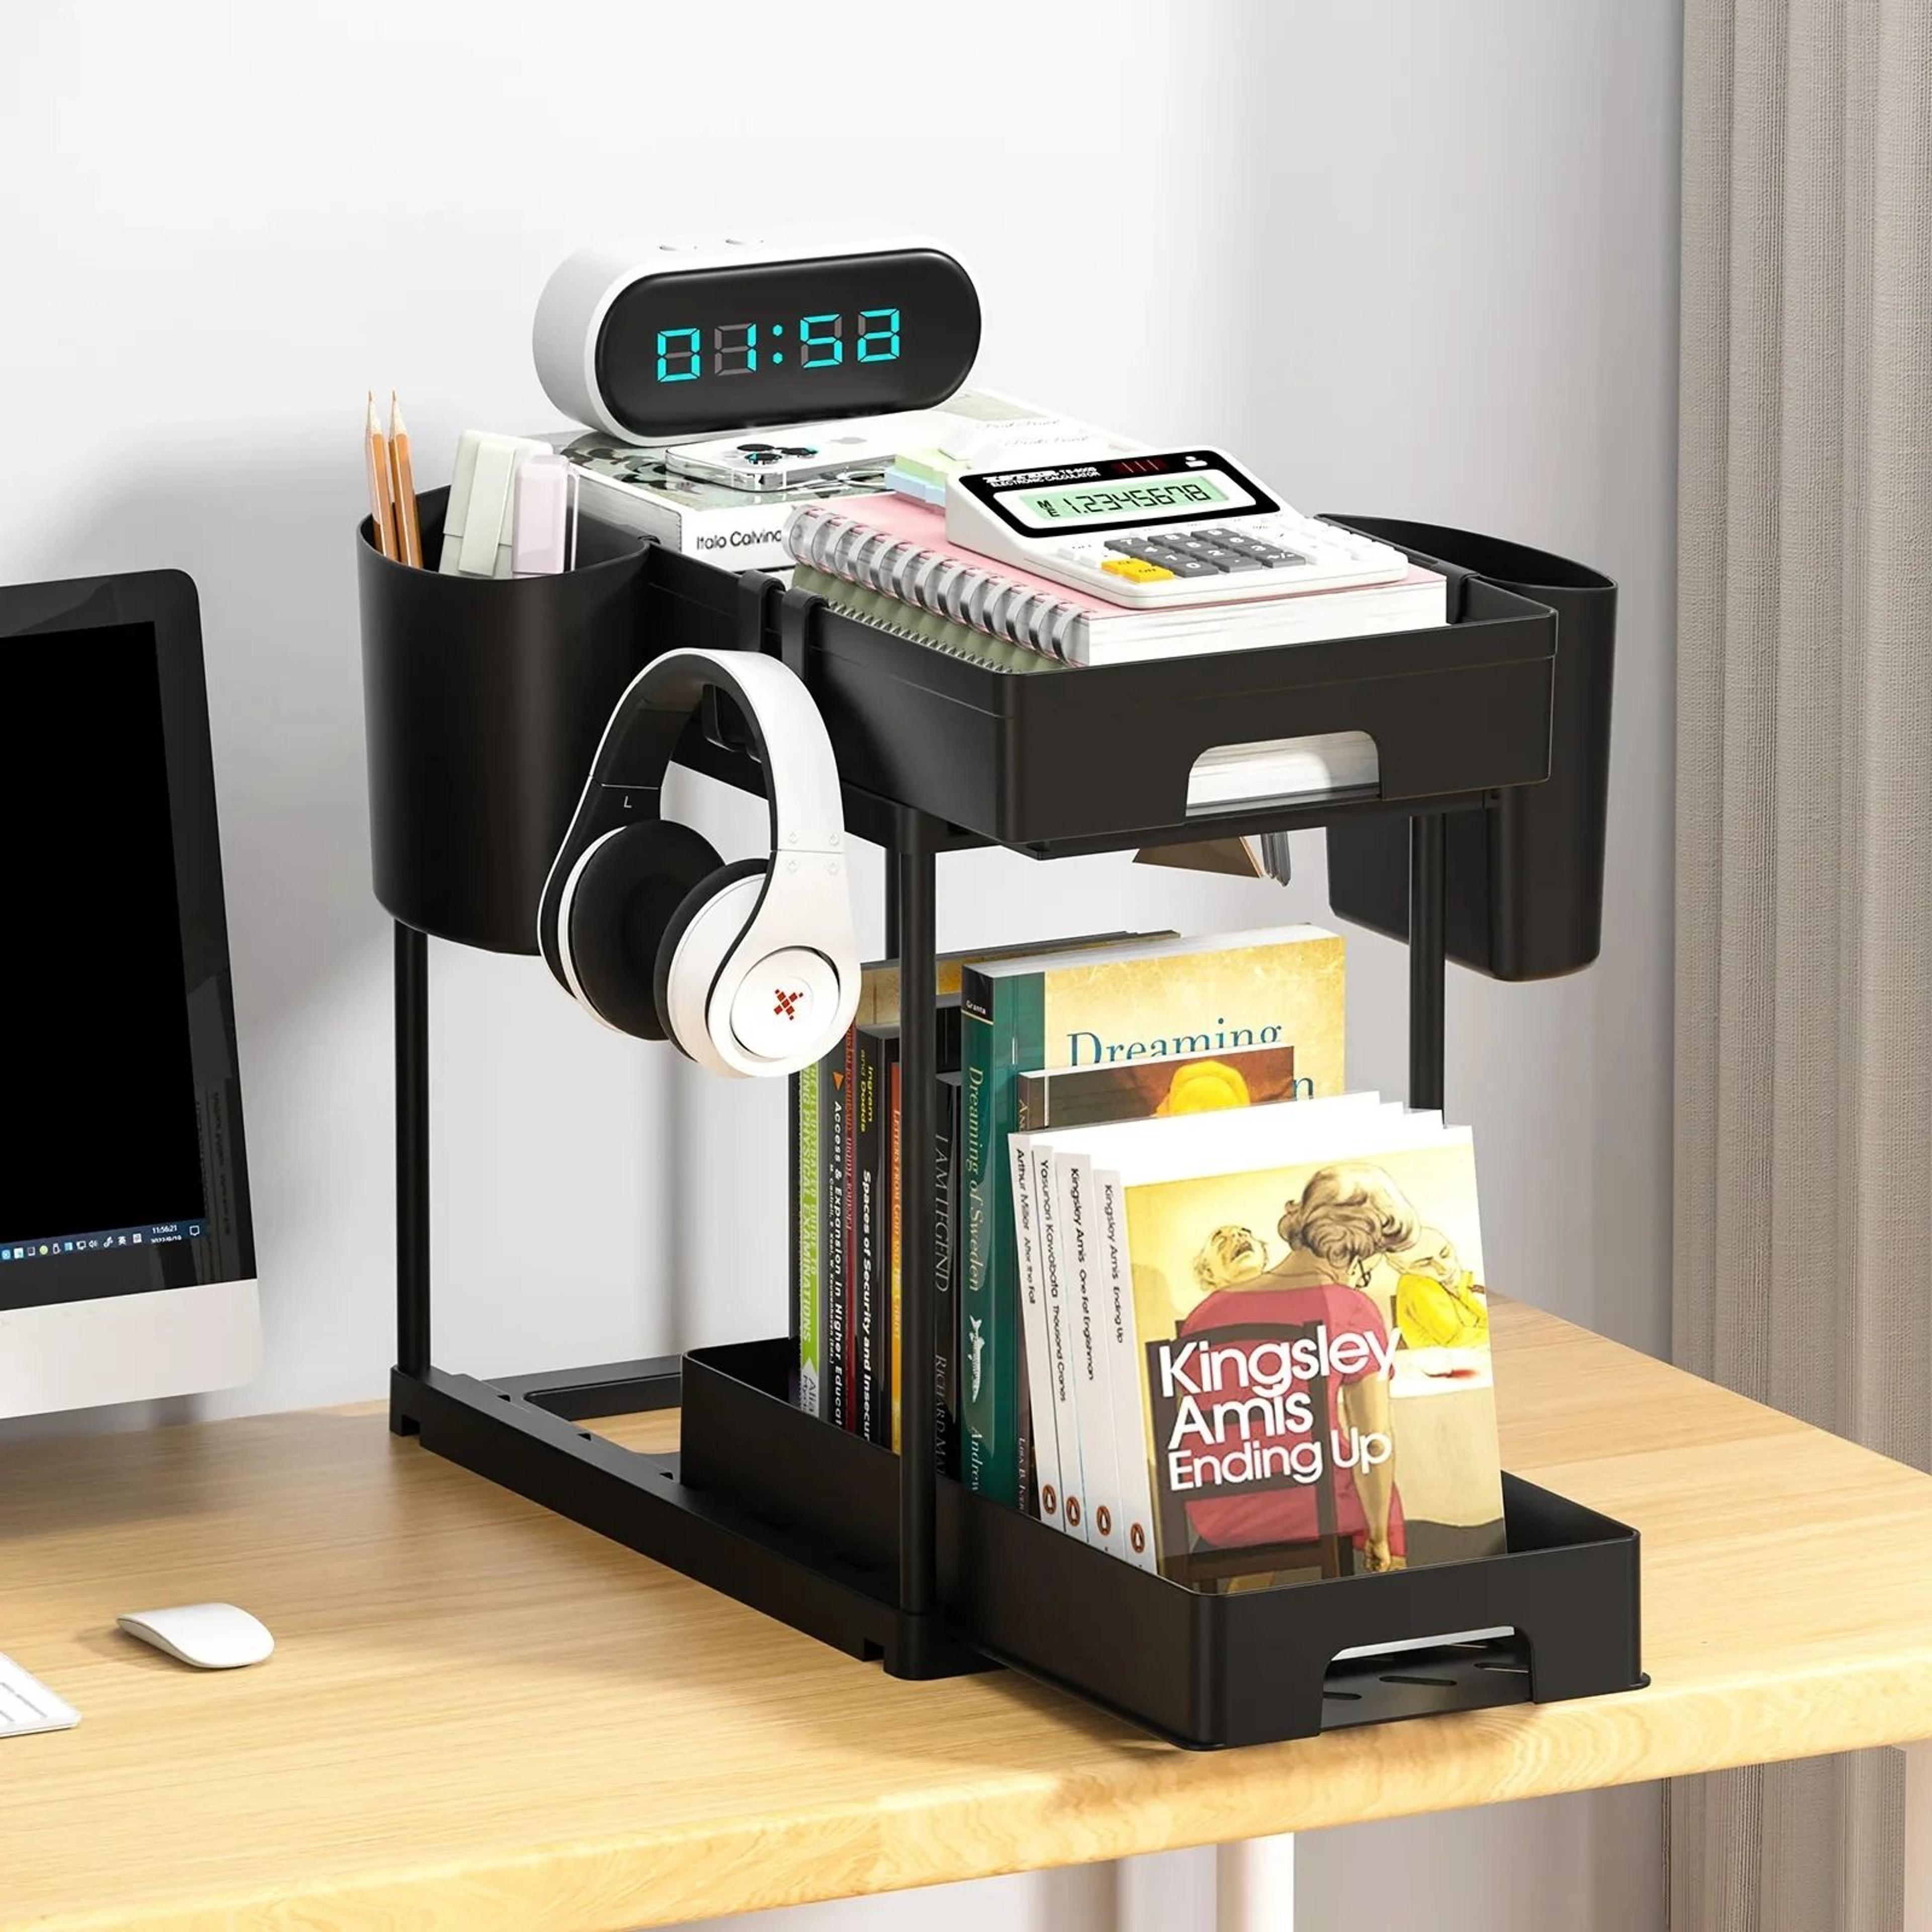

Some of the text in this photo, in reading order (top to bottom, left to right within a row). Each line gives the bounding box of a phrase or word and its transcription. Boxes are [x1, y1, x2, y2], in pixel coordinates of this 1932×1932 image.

[1063, 484, 1211, 514] 1.2345678
[696, 534, 727, 550] Italo
[623, 795, 632, 809] L
[965, 999, 987, 1015] Granta
[802, 1108, 811, 1198] PHYSICAL
[835, 1168, 842, 1180] &
[965, 1067, 984, 1292] Dreaming of Sweden
[1016, 1149, 1025, 1193] Arthur
[834, 1187, 842, 1275] Expansion
[862, 1169, 871, 1234] Spaces
[935, 1134, 950, 1293] I AM LEGEND
[1040, 1160, 1058, 1298] Yasunari Kawabata
[1070, 1168, 1085, 1263] Kingsley Amis
[1104, 1184, 1119, 1279] Kingsley Amis
[802, 1203, 811, 1342] EXAMINATIONS
[863, 1237, 871, 1257] of
[862, 1258, 871, 1334] Security
[1112, 1286, 1124, 1343] Ending Up
[834, 1305, 843, 1359] Higher
[863, 1336, 871, 1372] and
[1052, 1305, 1064, 1360] Thousand
[1158, 1325, 1402, 1398] Kingsley
[1167, 1392, 1315, 1450] Amis
[970, 1425, 984, 1492] Andrew
[1168, 1426, 1392, 1491] Ending Up
